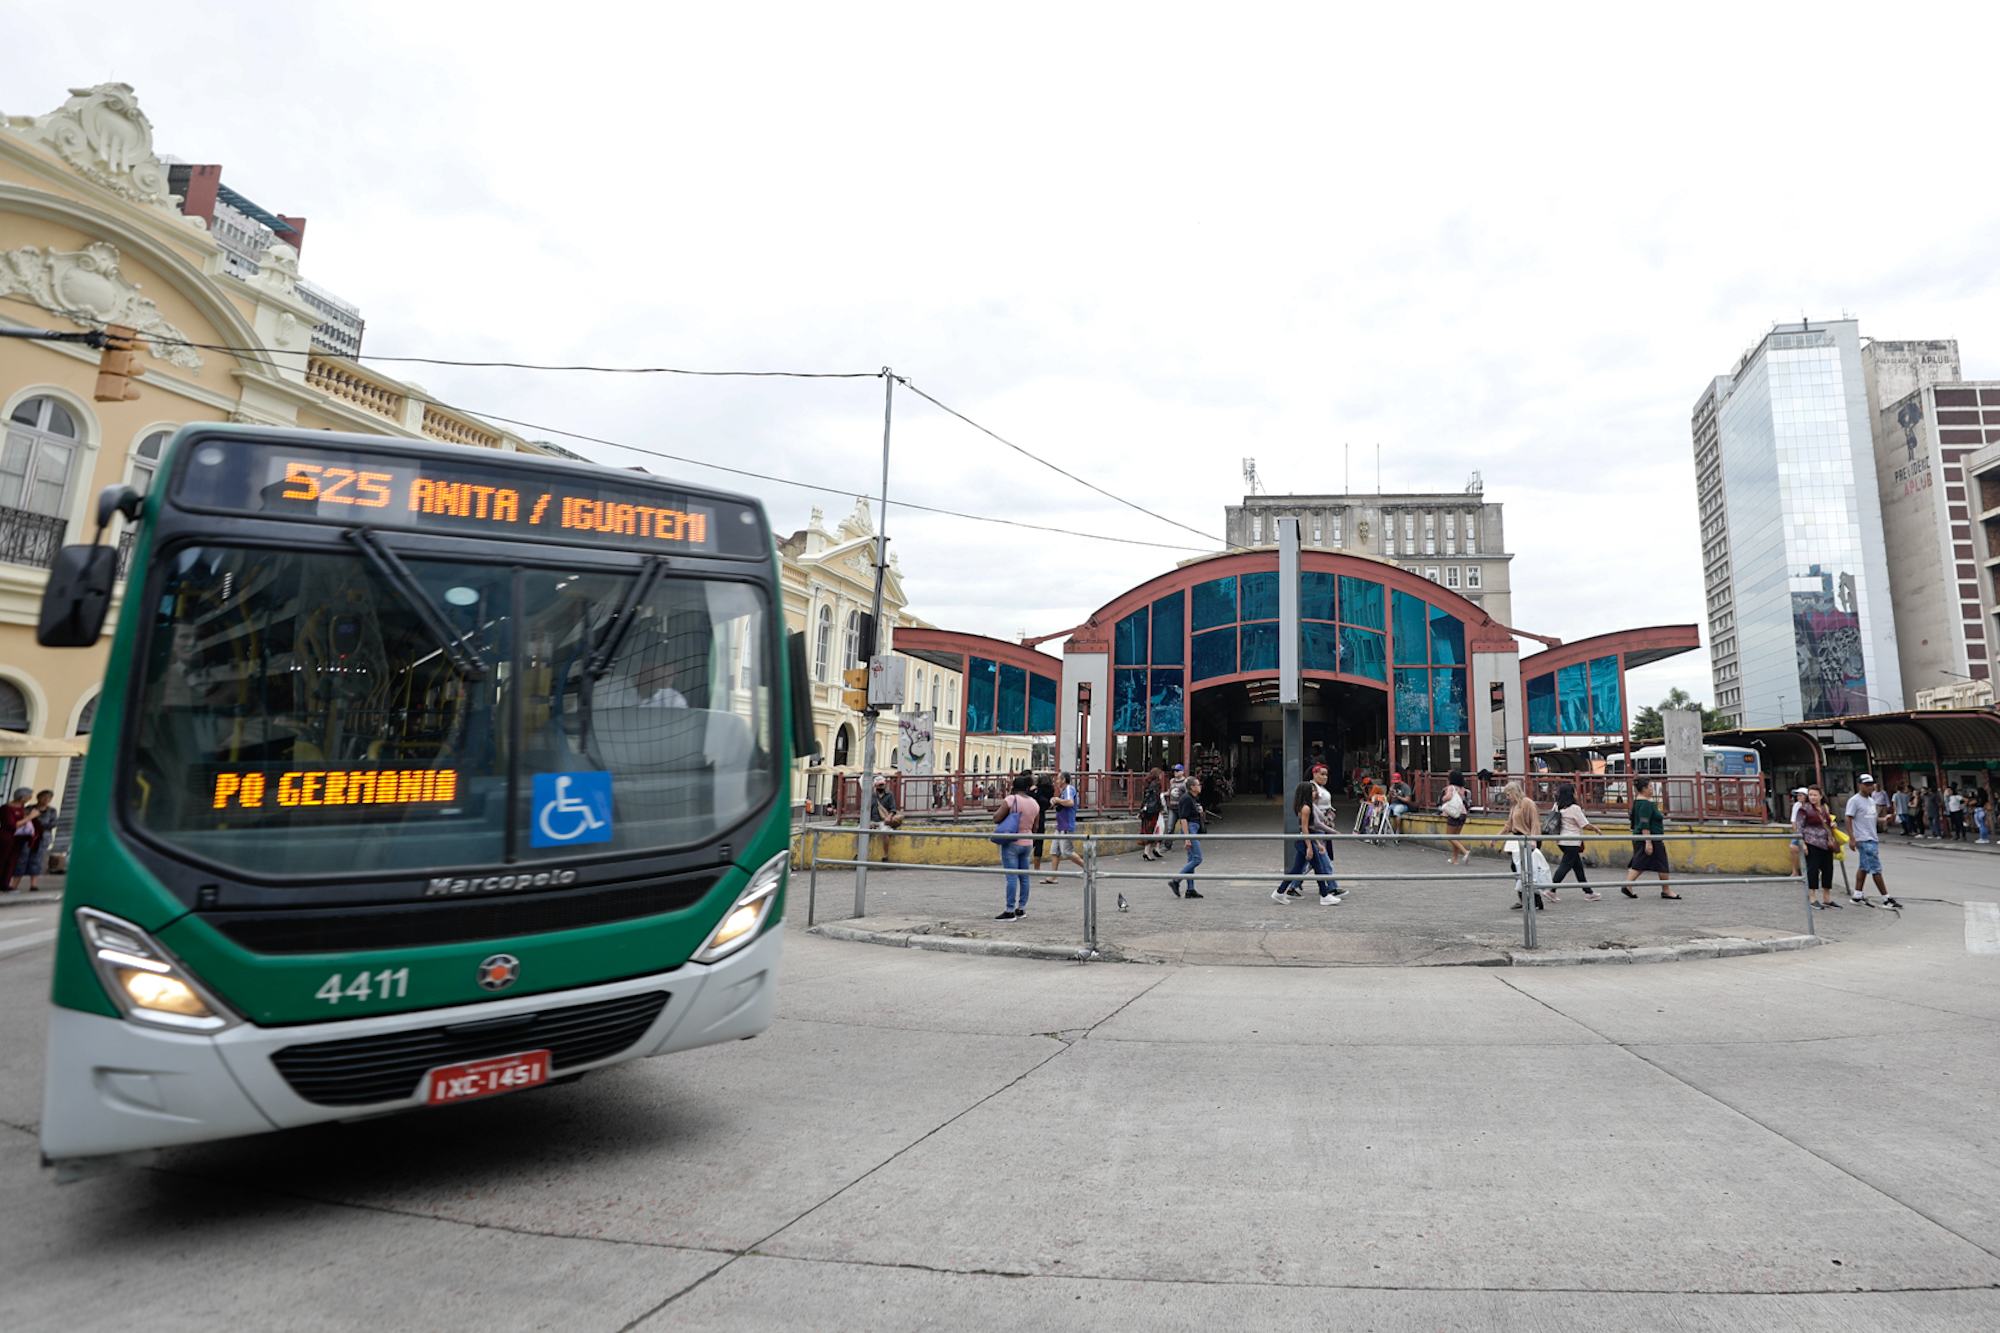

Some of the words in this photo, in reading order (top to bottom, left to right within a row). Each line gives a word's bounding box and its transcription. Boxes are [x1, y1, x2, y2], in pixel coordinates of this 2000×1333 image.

[282, 462, 393, 507] 525
[408, 477, 519, 522] ANITA
[561, 497, 706, 543] IGUATEMI
[426, 869, 576, 895] Marcopolo
[315, 967, 409, 1004] 4411
[436, 1063, 540, 1100] IXC-1451
